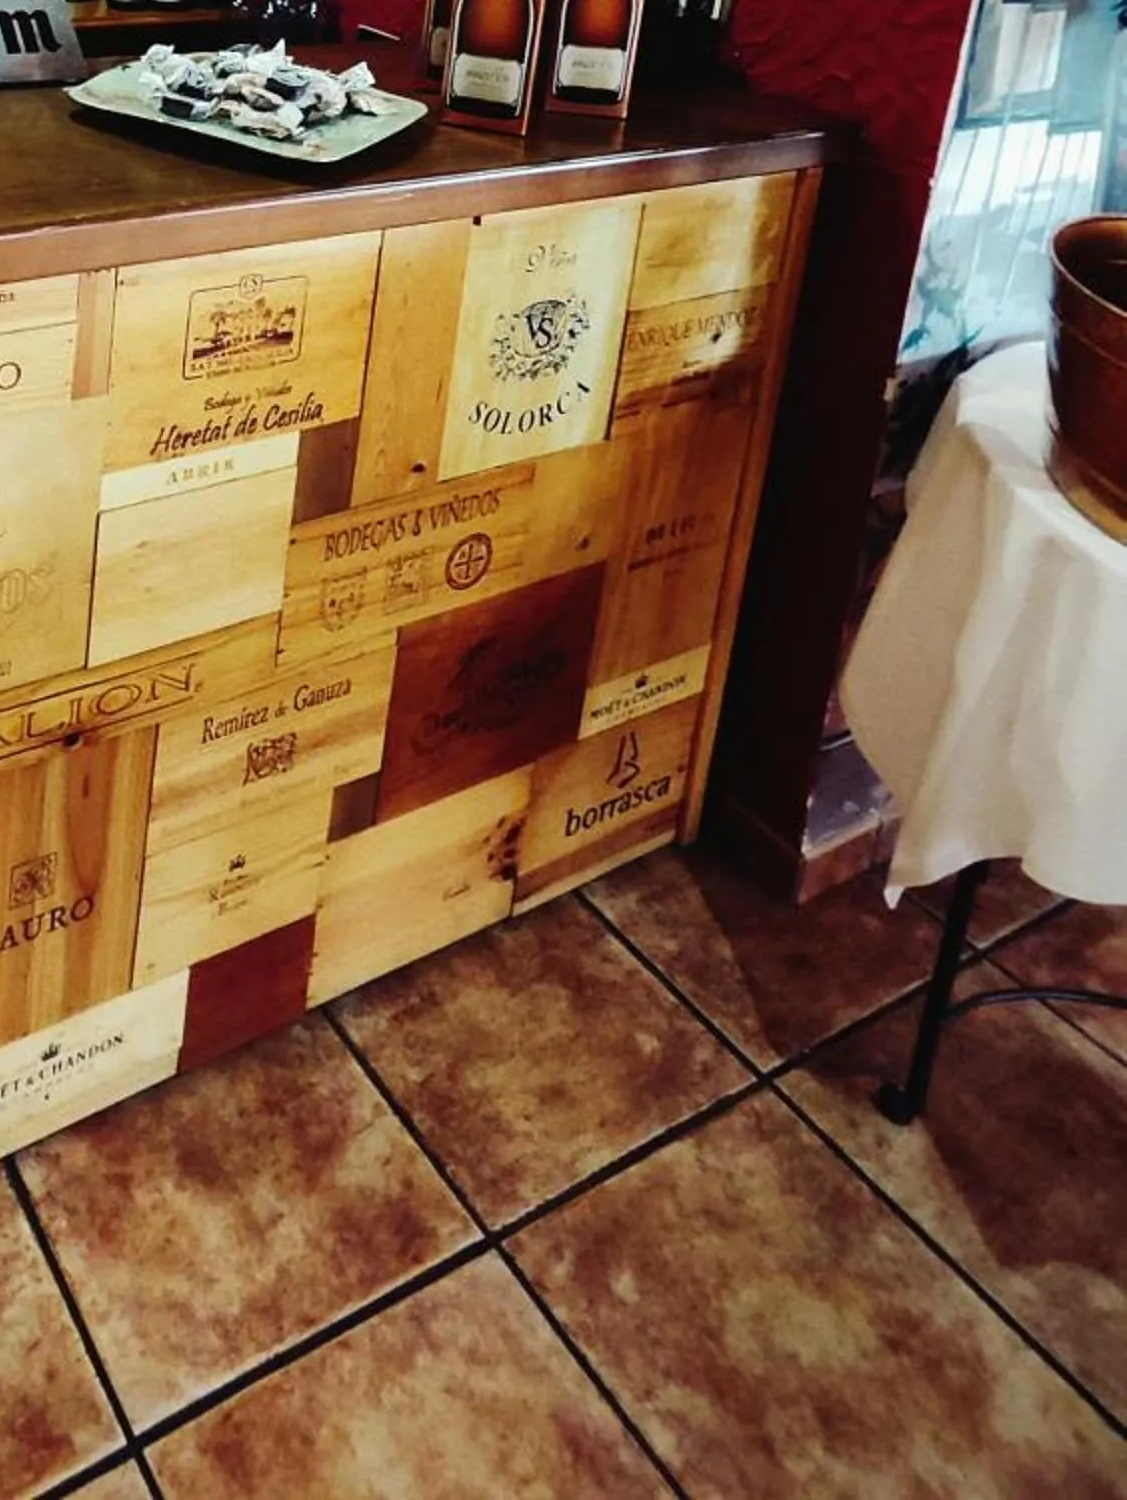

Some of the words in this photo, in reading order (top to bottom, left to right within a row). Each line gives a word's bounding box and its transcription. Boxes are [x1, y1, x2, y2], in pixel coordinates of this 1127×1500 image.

[149, 415, 233, 457] Heretat
[233, 402, 259, 438] de
[262, 390, 326, 431] Cesilia
[467, 382, 592, 436] SOLORCA
[323, 512, 409, 561] BODEGAS
[429, 486, 503, 530] VIÑEDOS
[293, 677, 353, 712] Ganuza
[564, 774, 672, 838] borrasca
[38, 1032, 126, 1079] CHANDON
